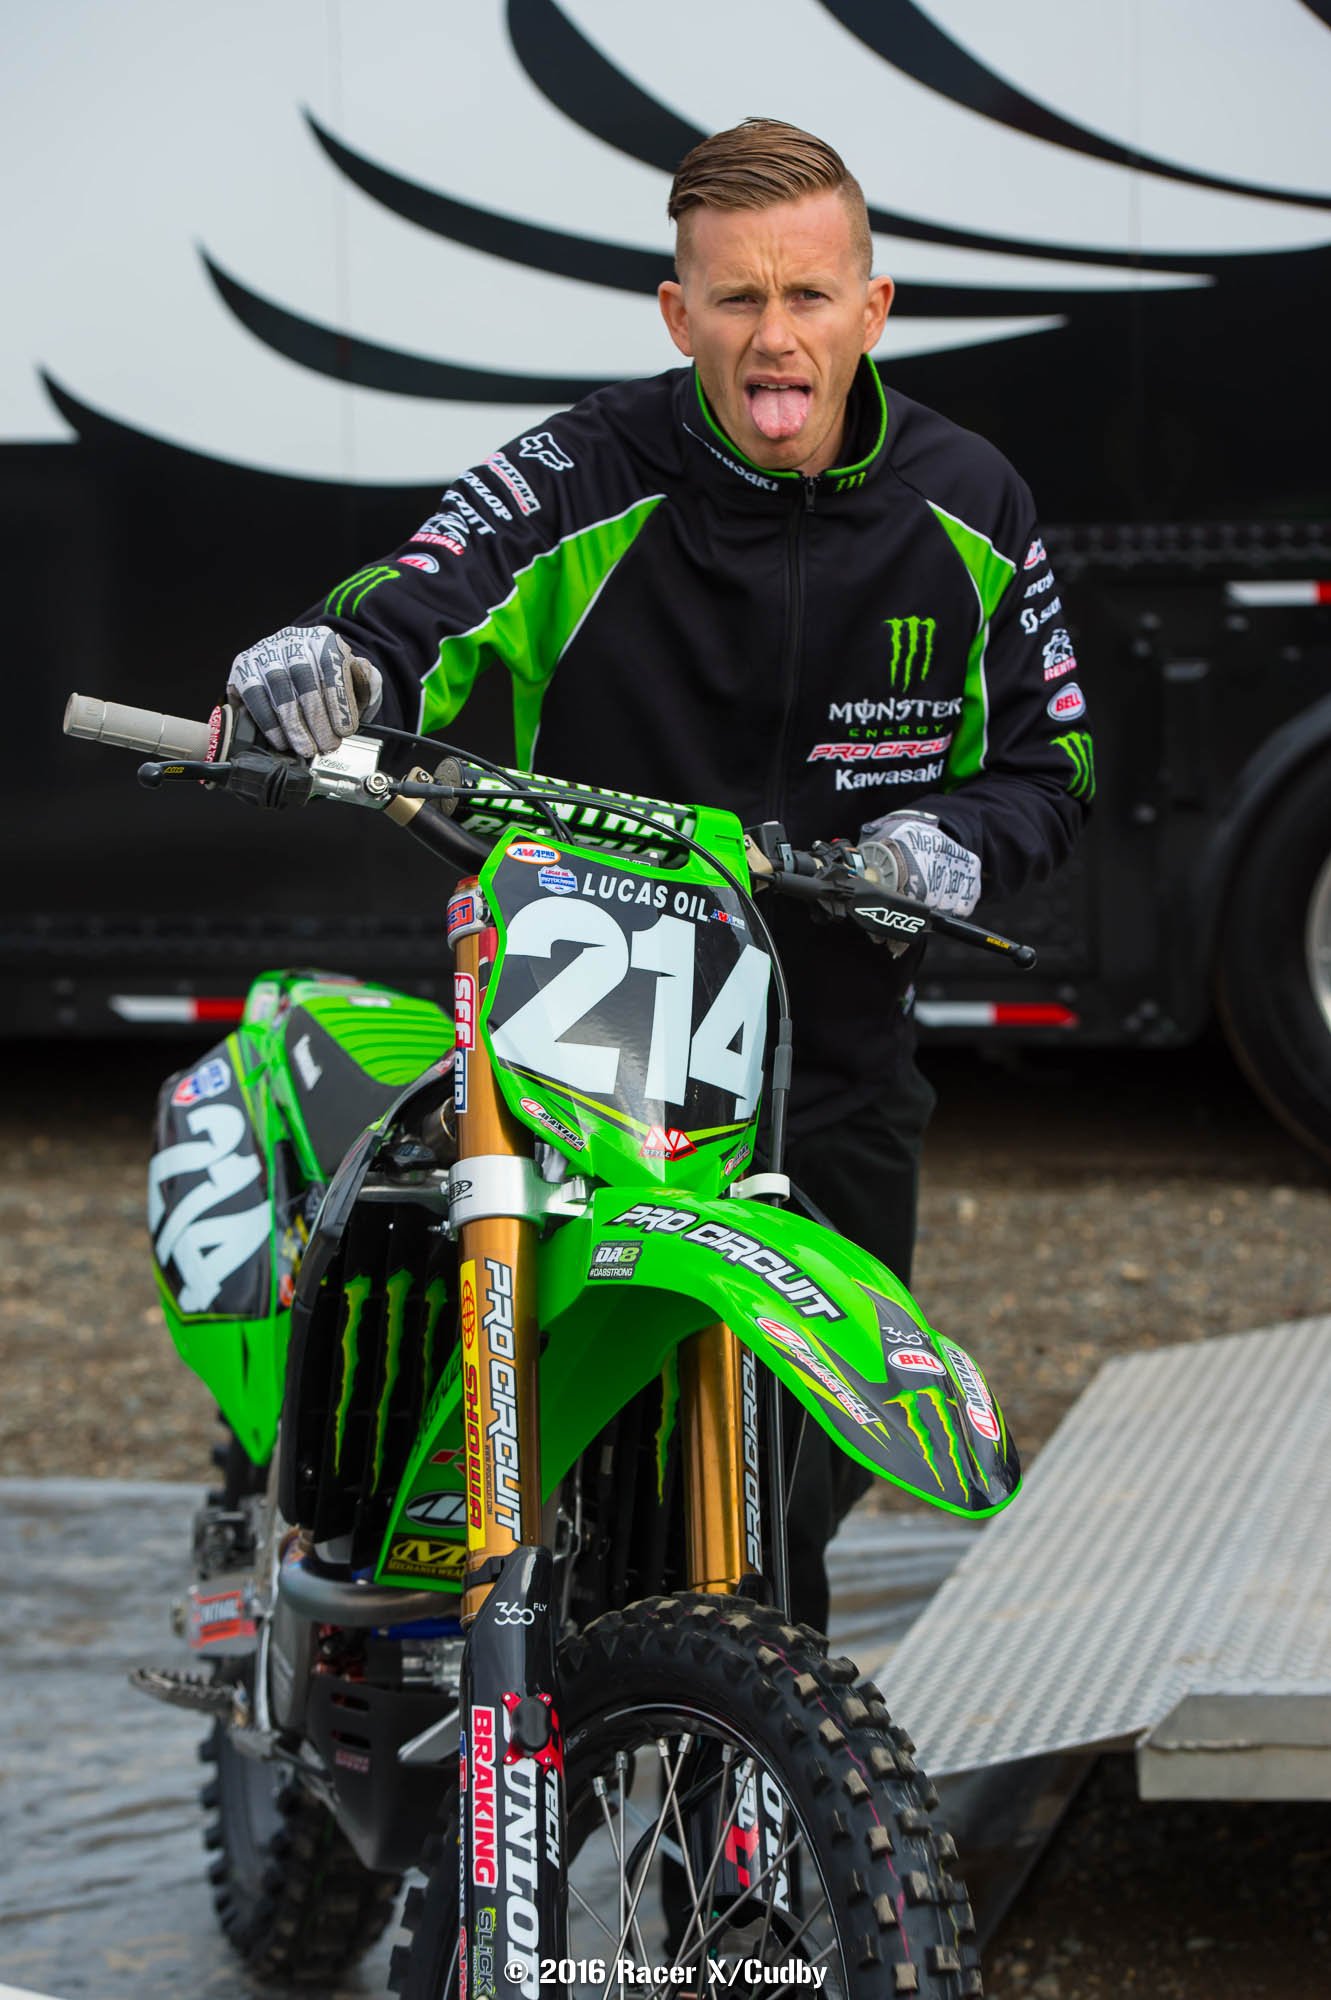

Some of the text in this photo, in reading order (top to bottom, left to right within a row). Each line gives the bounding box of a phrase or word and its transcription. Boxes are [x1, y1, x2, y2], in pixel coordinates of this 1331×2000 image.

[459, 471, 513, 521] NLOP
[410, 532, 464, 556] ENTHAL
[1044, 657, 1077, 682] RENTH
[828, 697, 963, 725] MONSTER
[1056, 692, 1081, 712] BELL
[849, 724, 944, 738] ENERGY
[807, 733, 952, 763] PRO CIRCU
[835, 759, 944, 791] Kawasaki
[512, 847, 541, 858] AMA
[582, 873, 668, 909] LUCAS
[855, 907, 926, 933] ARC
[456, 977, 472, 1045] SFF
[490, 896, 772, 1120] 214
[148, 1103, 272, 1313] 214
[595, 1247, 640, 1263] DA8
[612, 1205, 843, 1321] PRO CIRCUIT
[898, 1354, 940, 1370] BELL
[483, 1257, 522, 1543] PRO CIRCUIT
[838, 1393, 865, 1424] OILS
[465, 1361, 483, 1530] SHOWA
[743, 1351, 763, 1577] PRO CIRC
[494, 1601, 547, 1626] 360 FLY
[474, 1707, 497, 1885] BRAKING
[546, 1767, 561, 1870] TECH
[503, 1703, 540, 2000] UNLOP
